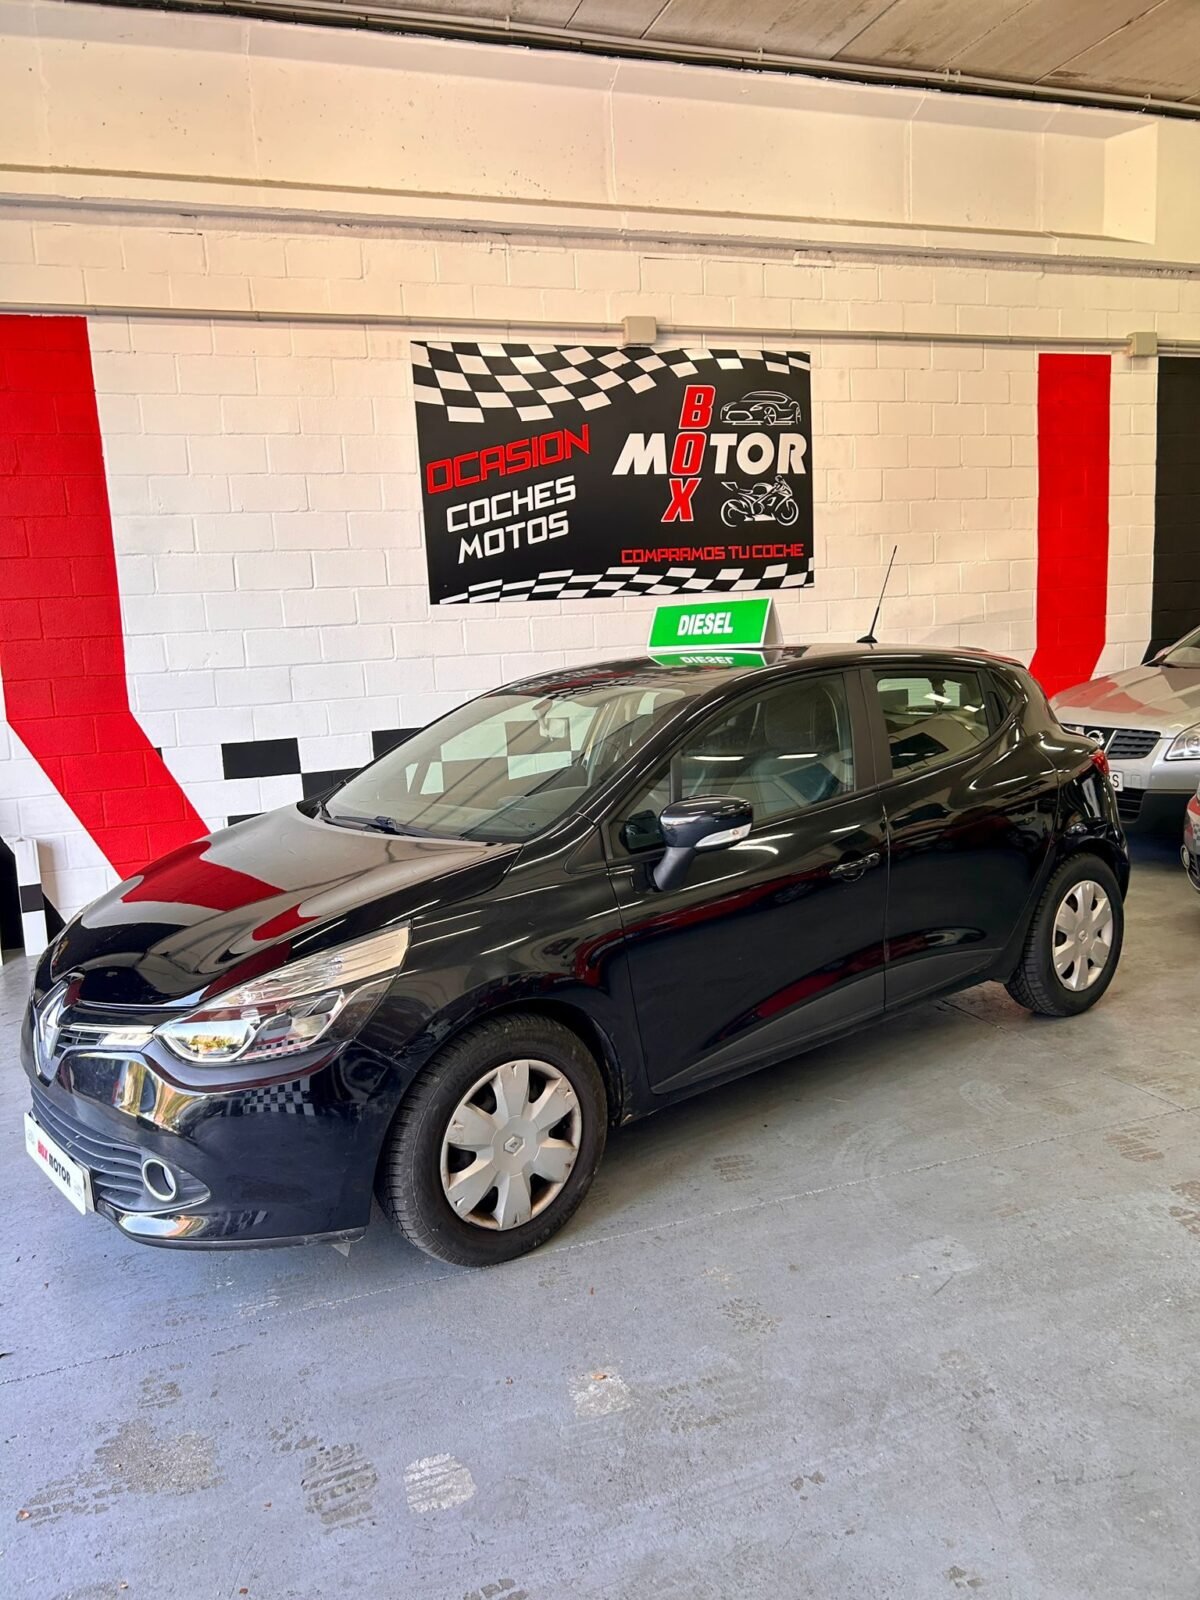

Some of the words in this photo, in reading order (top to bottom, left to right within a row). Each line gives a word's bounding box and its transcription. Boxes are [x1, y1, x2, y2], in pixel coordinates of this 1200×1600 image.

[426, 424, 590, 494] OCASION
[661, 384, 716, 522] BOX
[446, 475, 576, 532] COCHES
[458, 511, 568, 564] MOTOS
[621, 546, 726, 564] COMPRAMOS
[728, 545, 750, 559] TU
[751, 544, 803, 557] COCHE
[677, 612, 733, 636] DIESEL
